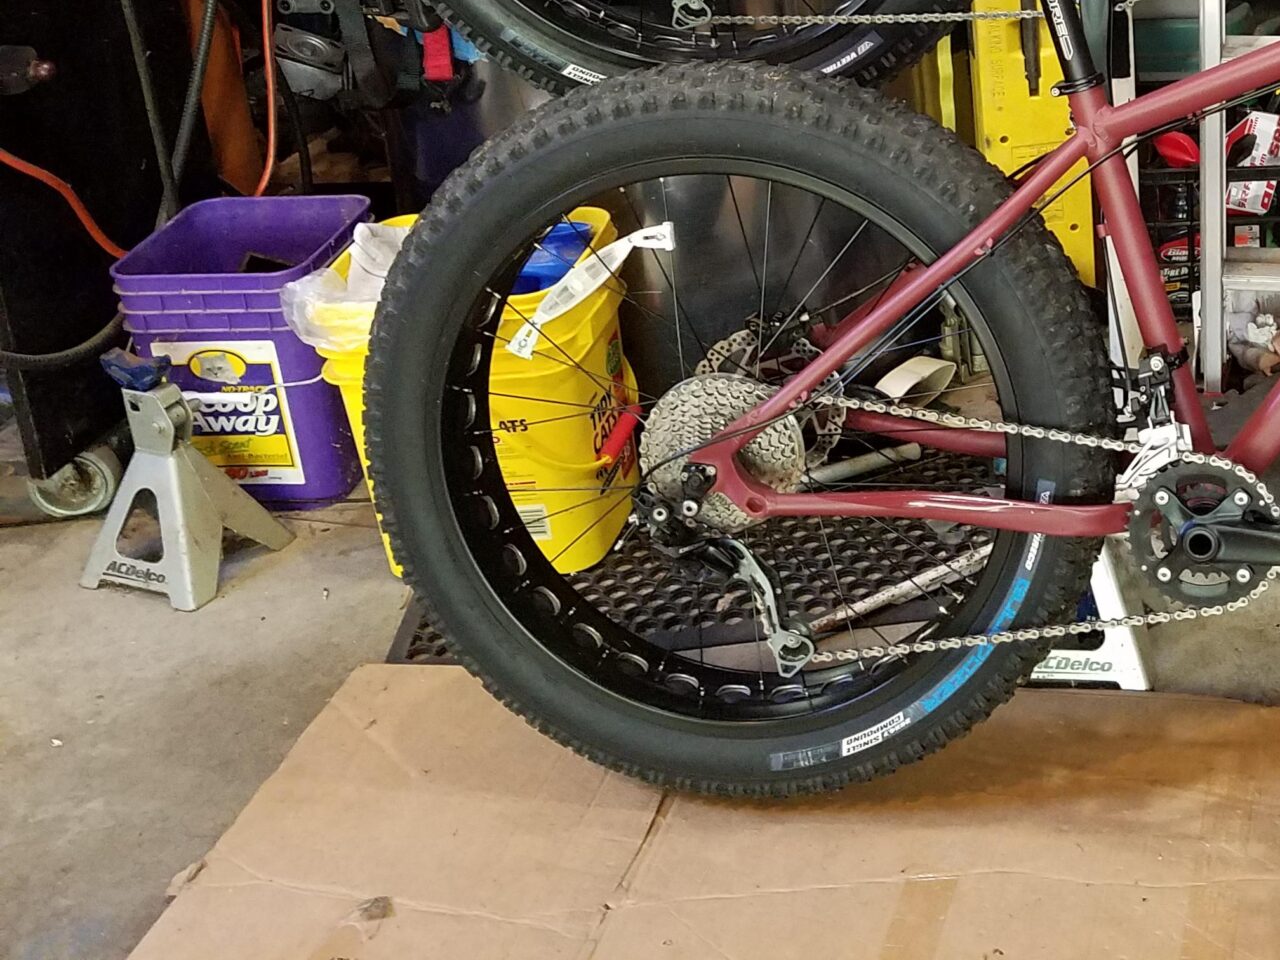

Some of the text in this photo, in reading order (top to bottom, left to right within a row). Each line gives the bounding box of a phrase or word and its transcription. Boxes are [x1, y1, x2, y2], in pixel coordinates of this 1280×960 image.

[192, 413, 280, 436] Away
[105, 560, 167, 584] ACDelco
[845, 714, 901, 746] COMPOUND
